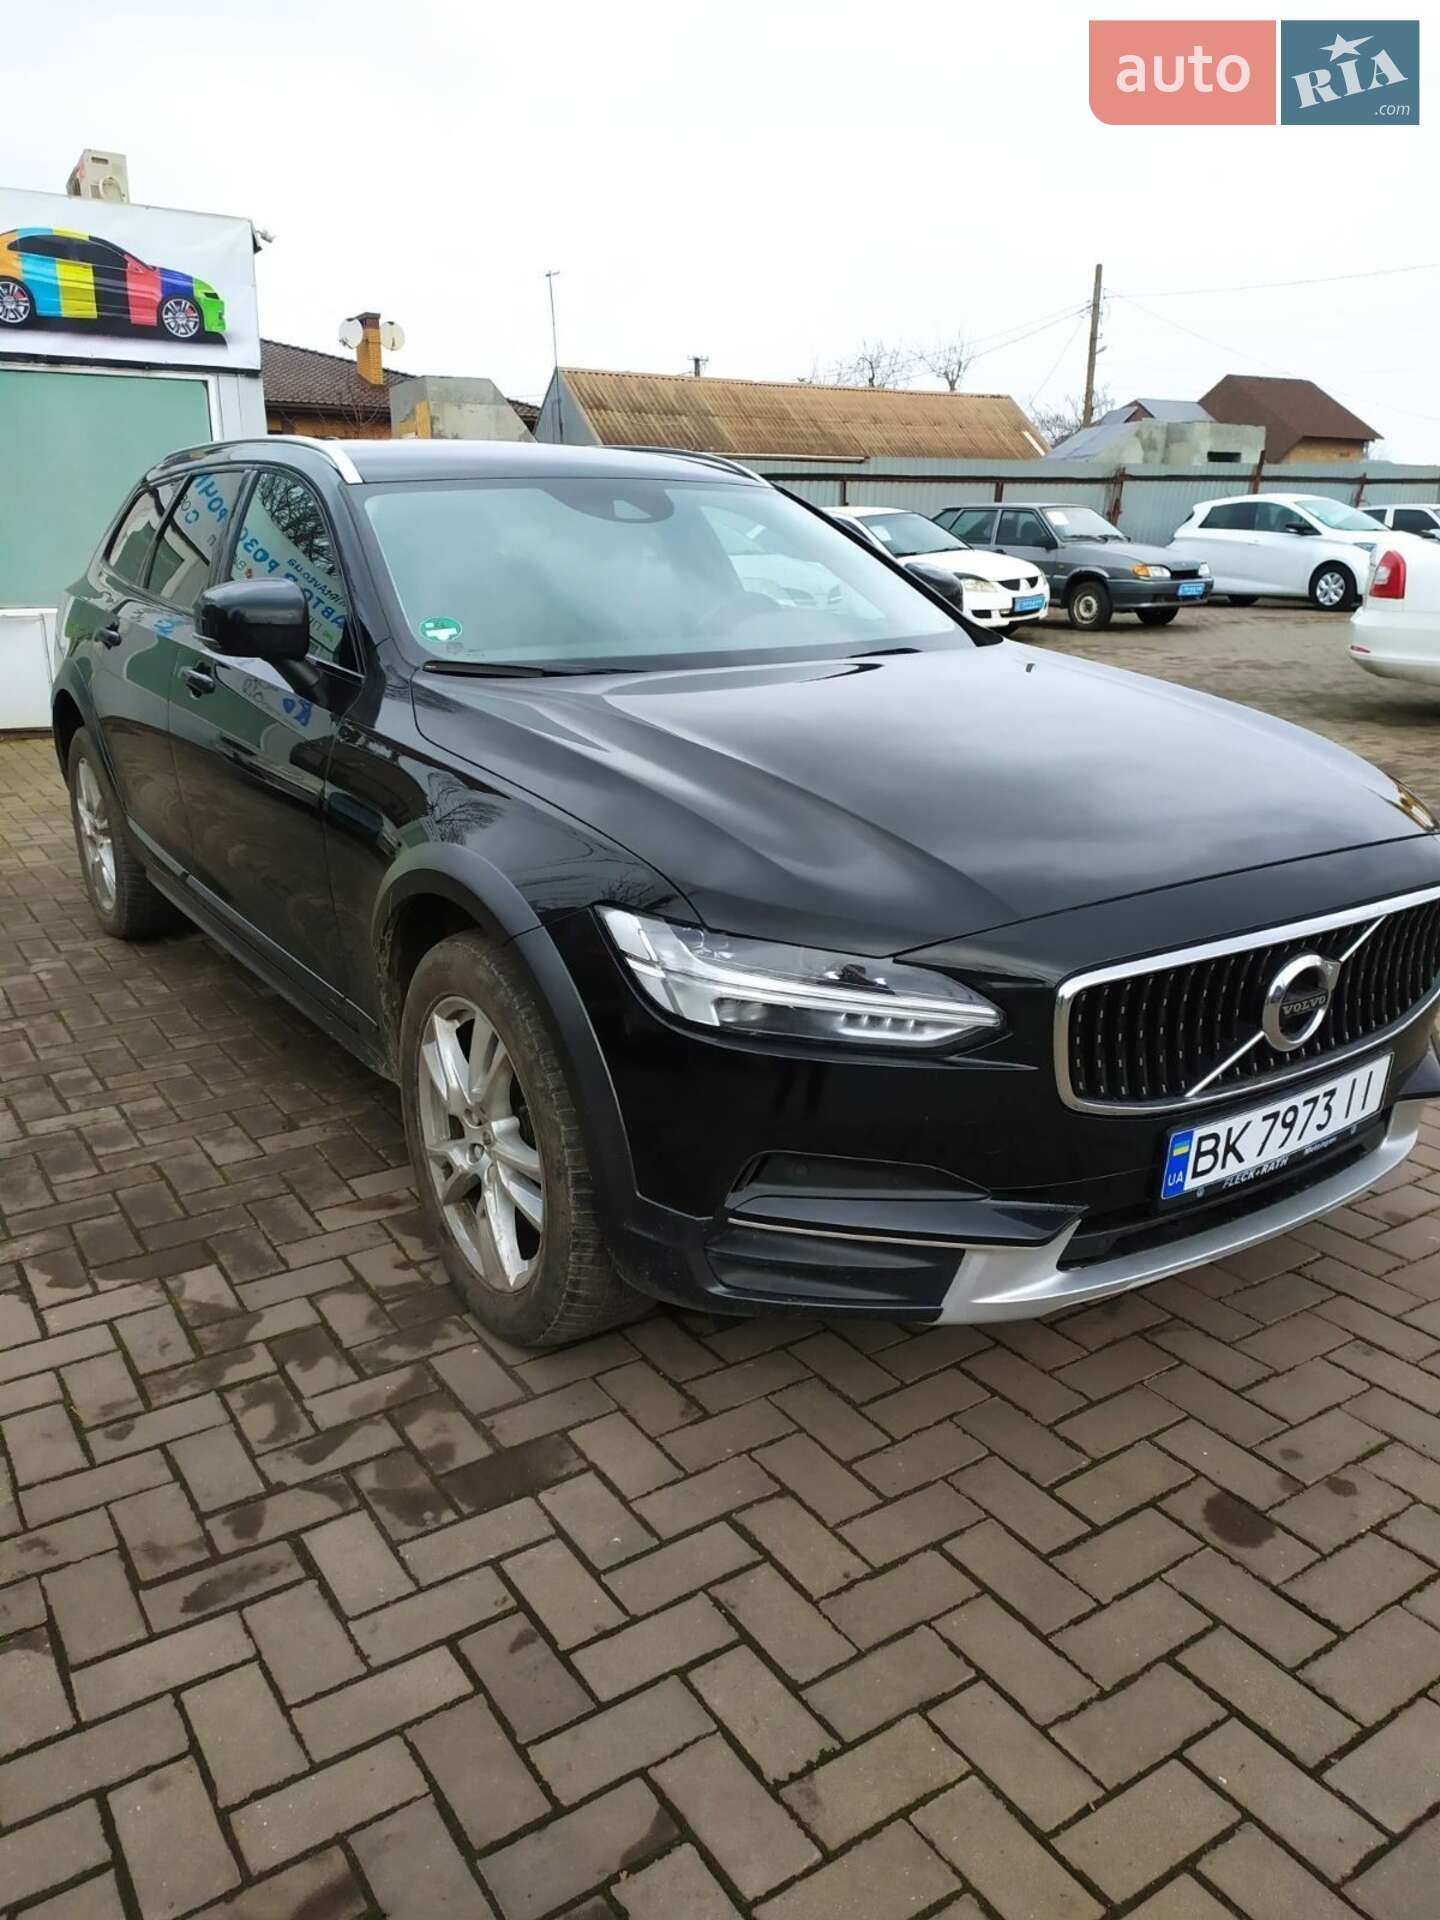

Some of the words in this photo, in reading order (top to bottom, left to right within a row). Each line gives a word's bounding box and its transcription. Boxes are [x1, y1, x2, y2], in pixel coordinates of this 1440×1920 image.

[1282, 995, 1327, 1016] VOLVO
[1190, 1120, 1252, 1180] BK
[1256, 1087, 1338, 1158] 7973
[1167, 1174, 1184, 1188] UA
